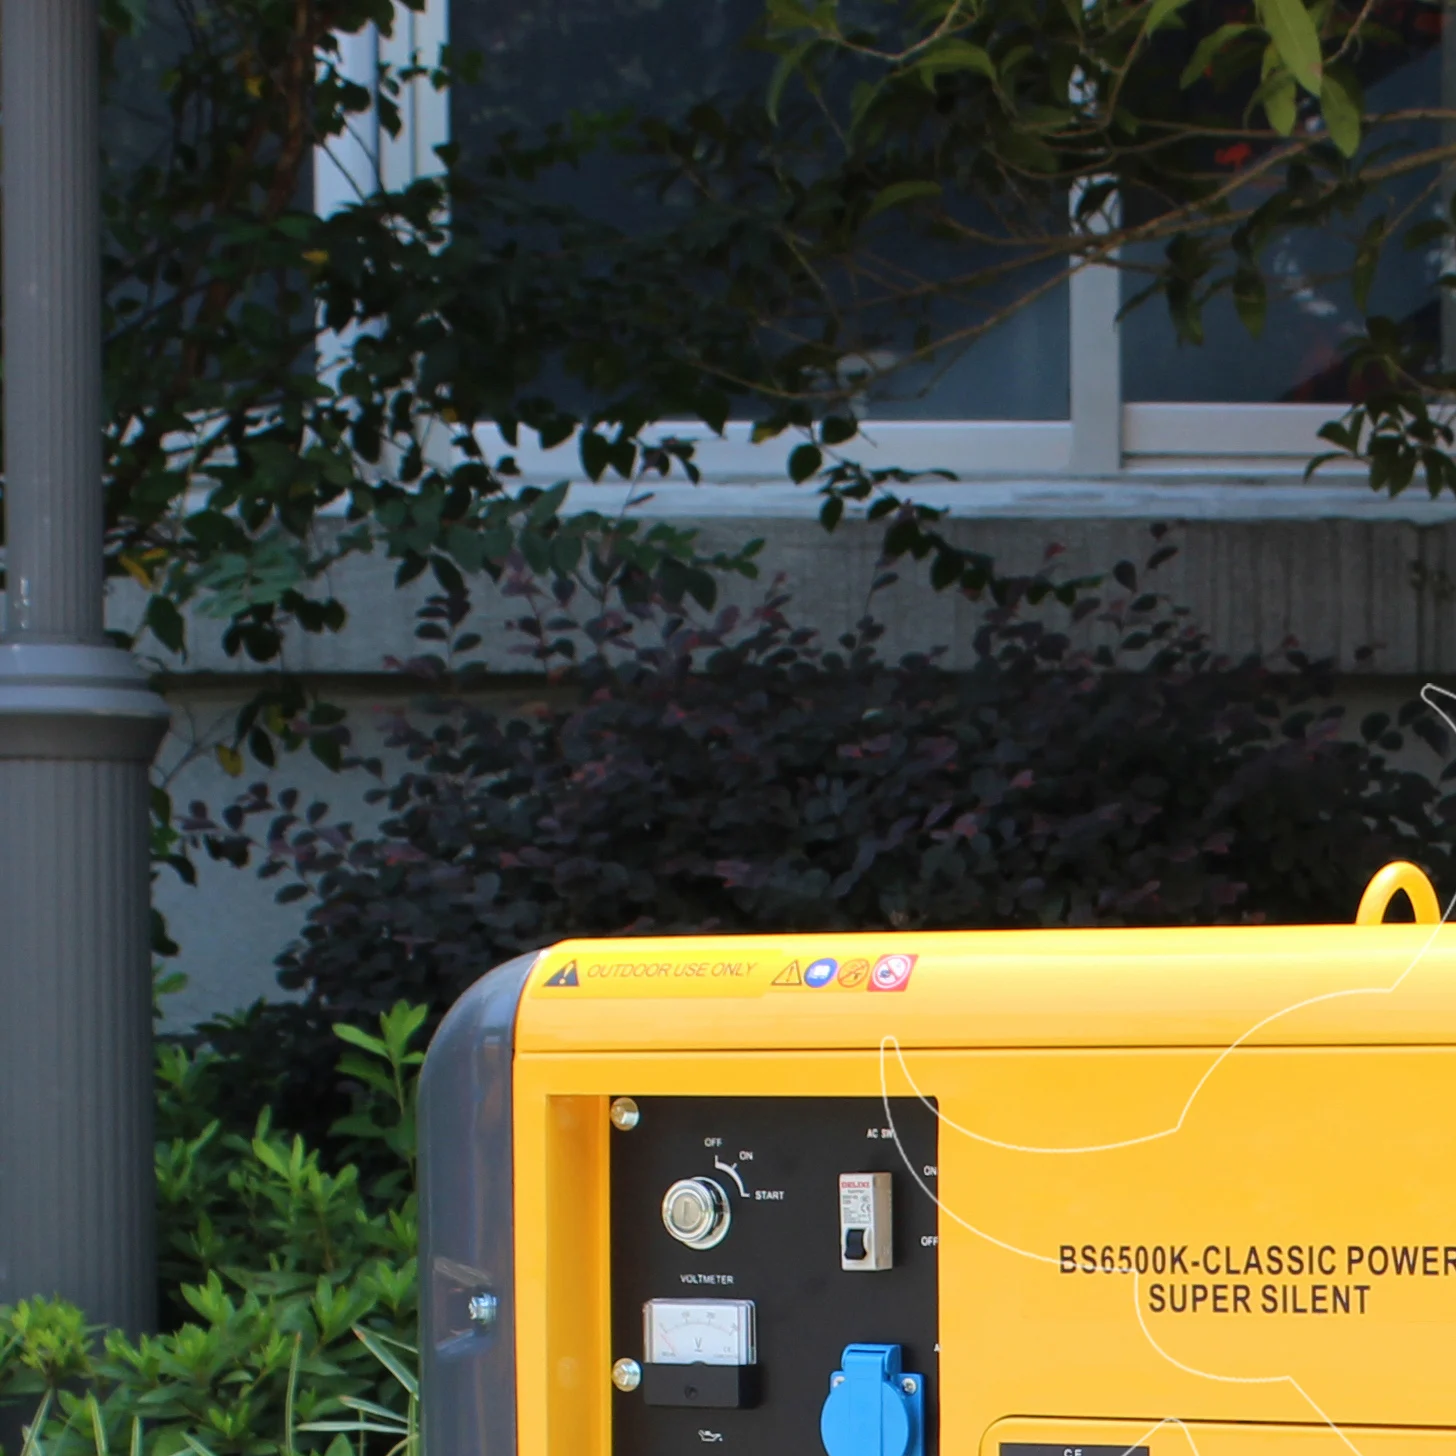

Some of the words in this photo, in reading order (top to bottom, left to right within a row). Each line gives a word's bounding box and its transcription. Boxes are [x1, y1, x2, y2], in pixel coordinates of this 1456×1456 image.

[586, 963, 672, 978] OUTDOOR
[674, 963, 710, 978] USE
[711, 962, 758, 977] ONLY
[866, 1128, 879, 1138] AC
[704, 1137, 723, 1147] OFF
[739, 1150, 753, 1160] ON
[755, 1190, 785, 1201] START
[1059, 1245, 1337, 1276] BS6500K-CLASSIC
[680, 1273, 735, 1285] VOLTMETER
[1149, 1284, 1253, 1314] SUPER
[1261, 1284, 1371, 1315] SILENT
